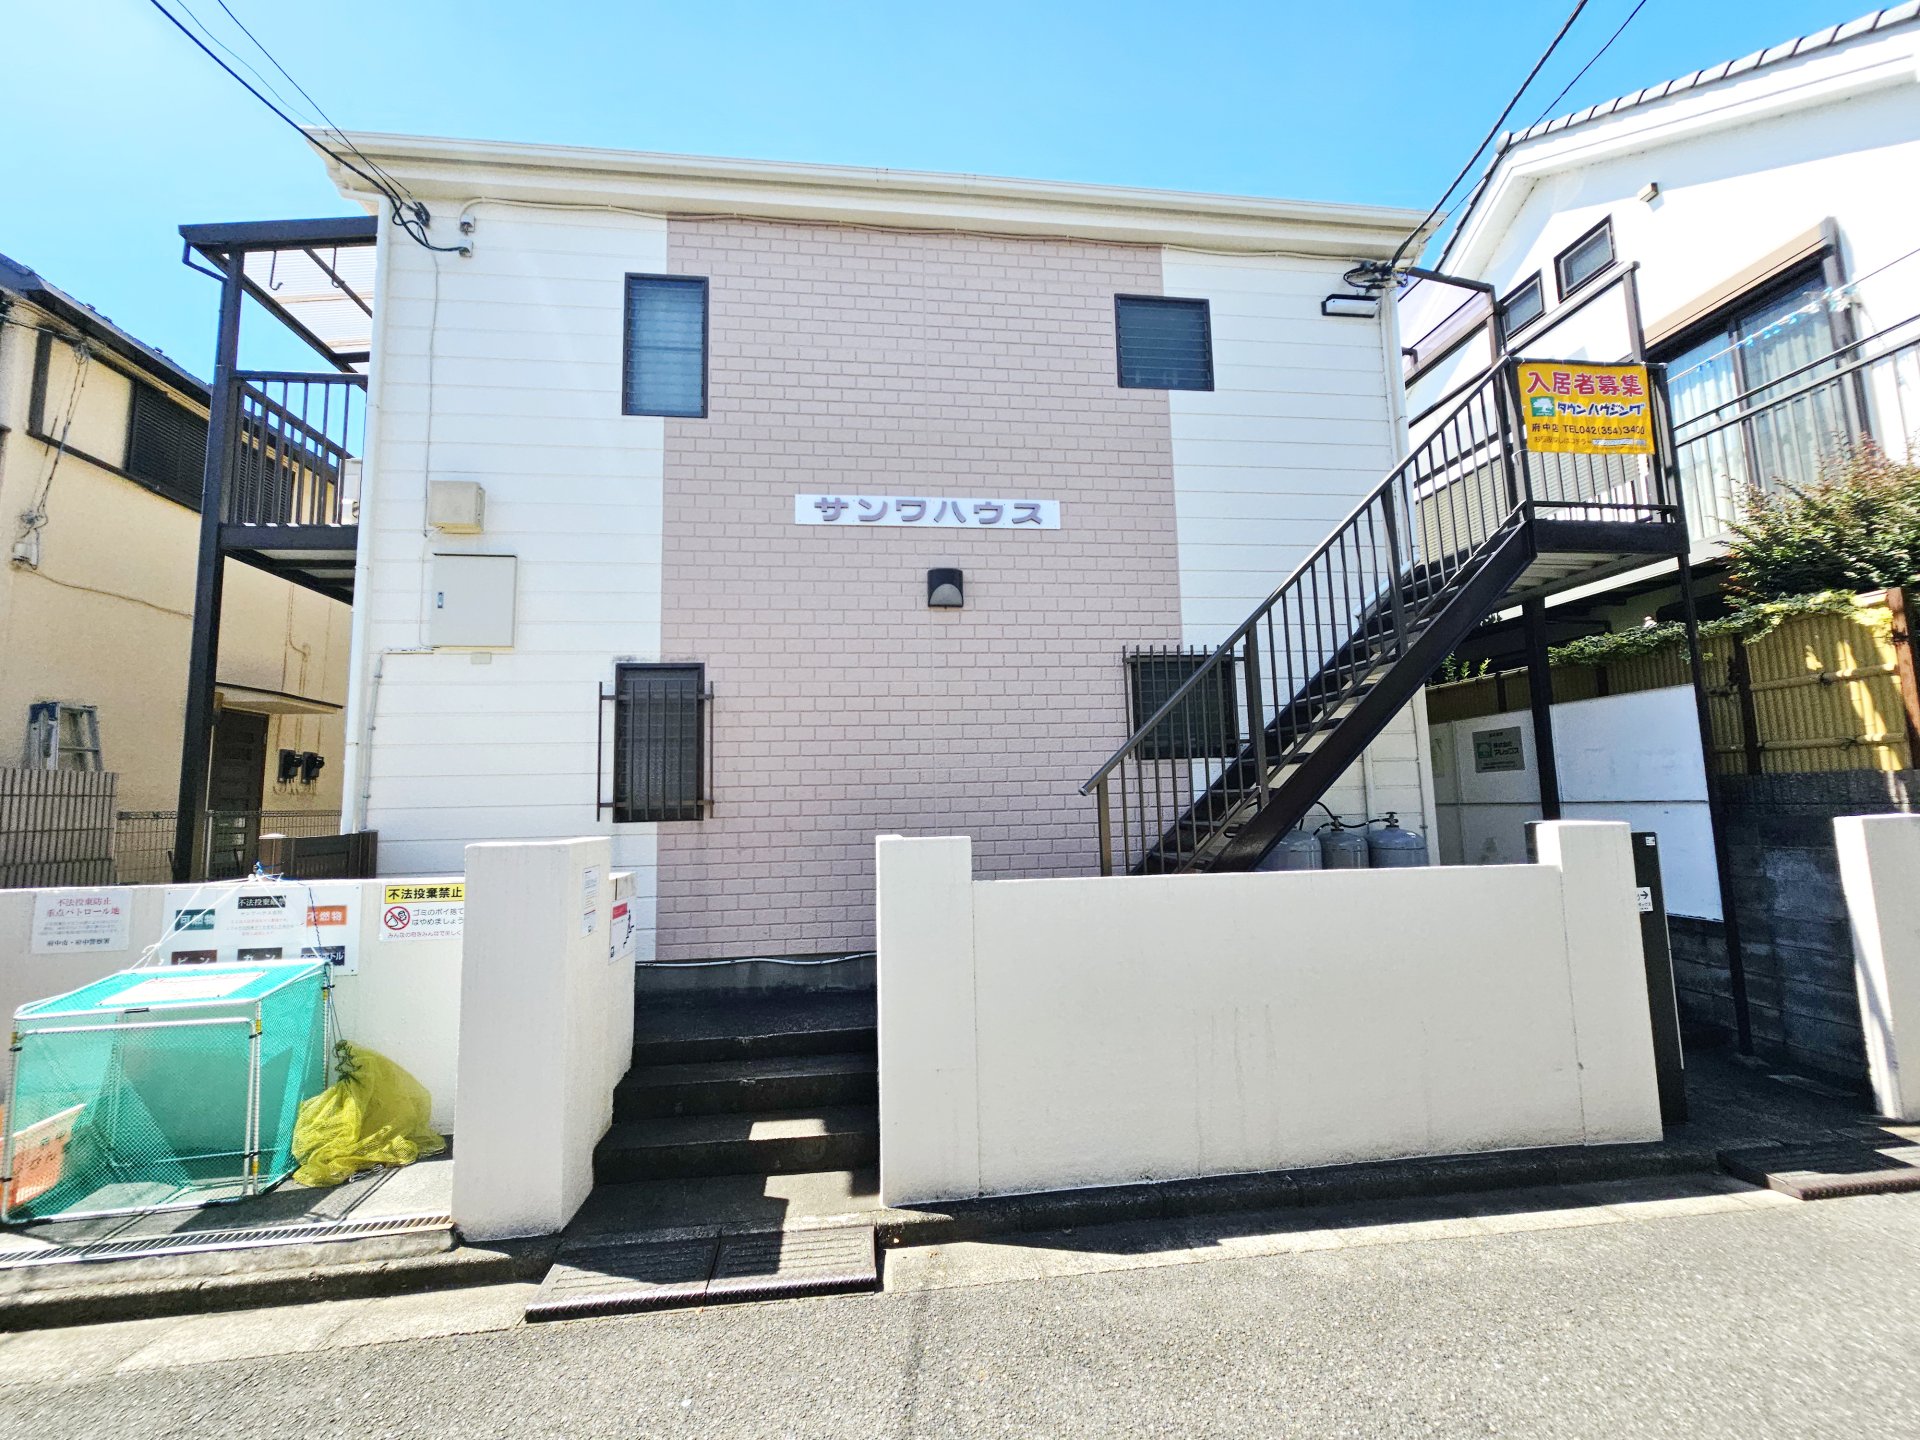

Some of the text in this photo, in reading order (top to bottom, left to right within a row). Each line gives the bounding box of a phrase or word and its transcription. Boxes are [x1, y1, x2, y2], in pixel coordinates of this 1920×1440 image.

[1526, 371, 1644, 397] 入居者募集
[1557, 401, 1645, 417] タウンハウジング
[1531, 422, 1559, 433] 府中店
[814, 497, 1042, 525] サンワハウス
[388, 886, 463, 900] 不法投棄禁止
[180, 914, 215, 926] 可燃物
[307, 911, 342, 923] 不燃物
